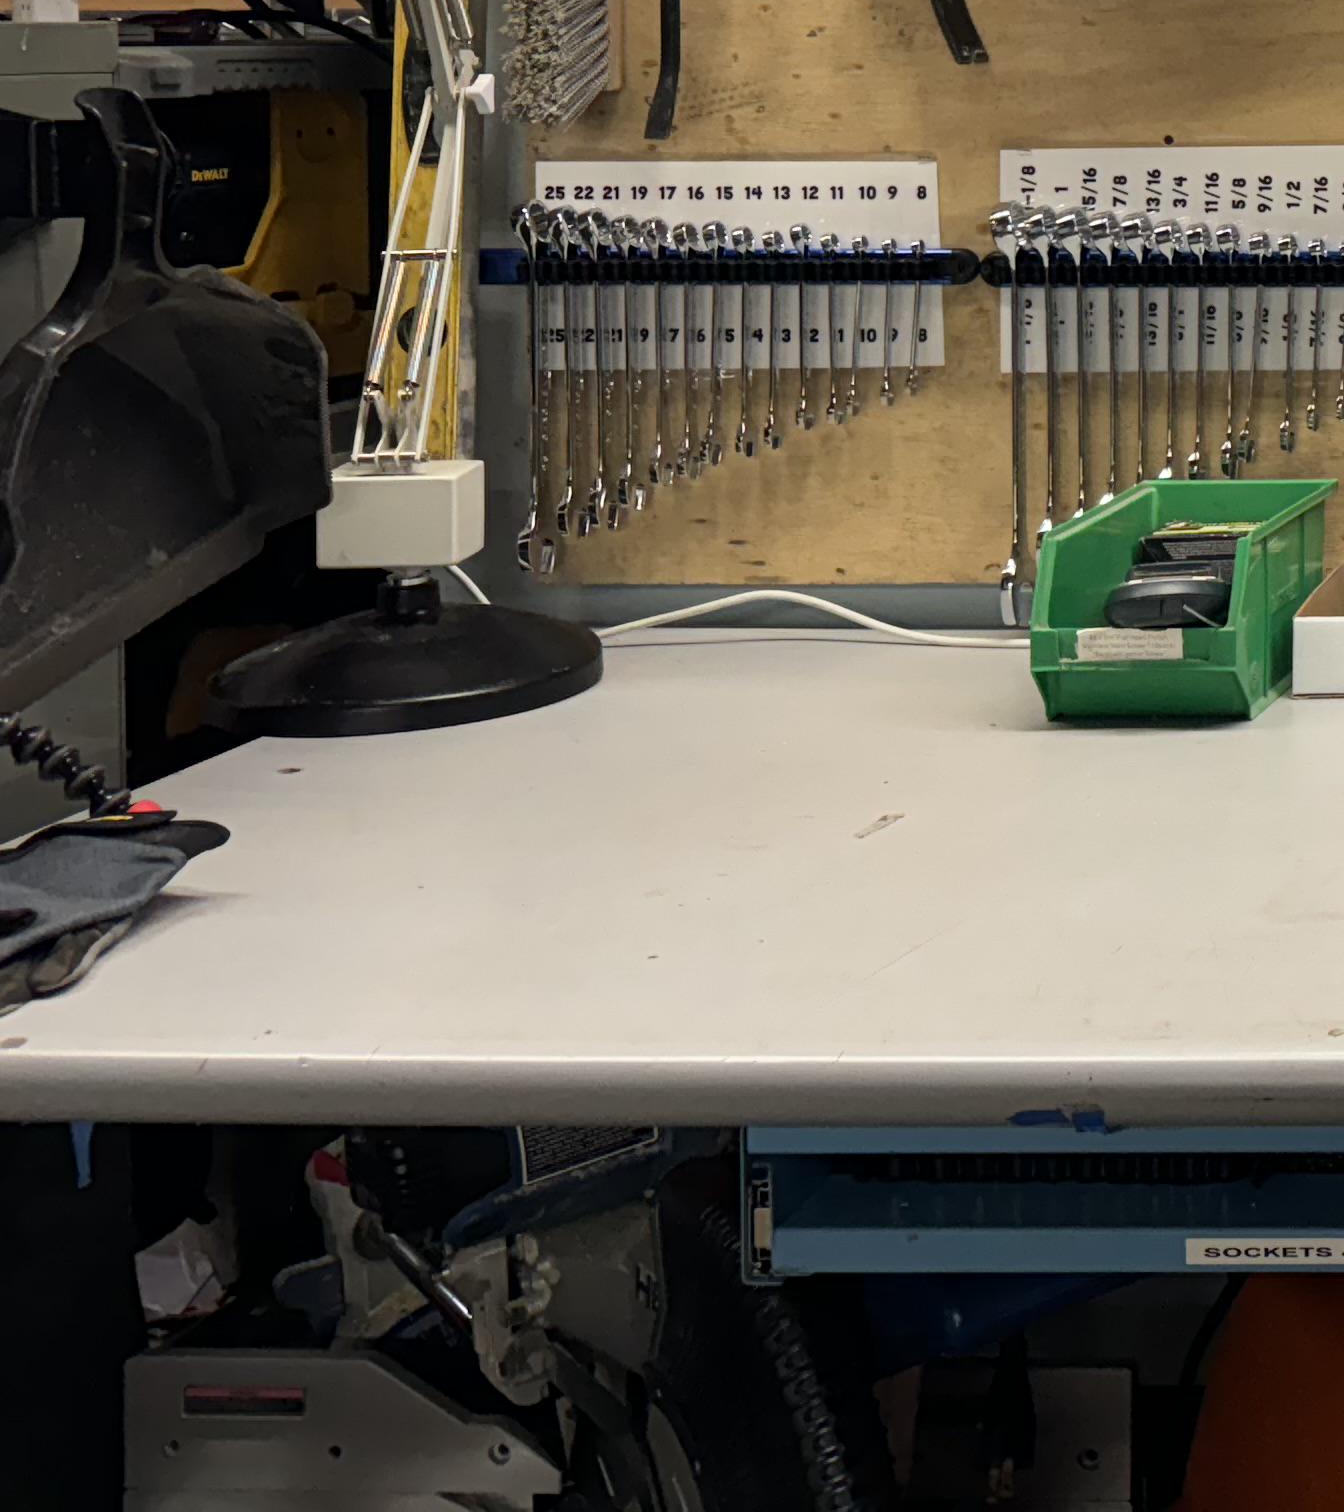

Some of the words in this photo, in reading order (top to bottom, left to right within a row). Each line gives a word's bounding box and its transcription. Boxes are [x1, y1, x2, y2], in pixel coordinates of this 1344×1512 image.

[190, 166, 230, 183] DEWALT
[544, 186, 565, 200] 25
[574, 186, 594, 200] 22
[602, 186, 620, 200] 21
[630, 186, 648, 200] 19
[659, 186, 676, 200] 17
[687, 186, 704, 200] 16
[716, 186, 734, 200] 15
[745, 186, 763, 200] 14
[773, 186, 791, 200] 13
[801, 186, 819, 200] 12
[830, 186, 844, 200] 11
[859, 186, 876, 200] 10
[887, 186, 898, 200] 9
[916, 186, 927, 200] 8
[1113, 175, 1128, 207] 7/8
[1173, 176, 1188, 209] 3/4
[1205, 172, 1220, 213] 11/16
[1231, 177, 1247, 210] 5/8
[1257, 175, 1273, 213] 9/16
[1286, 180, 1301, 210] 1/2
[1314, 176, 1329, 214] 7/16
[860, 328, 877, 343] 10
[1204, 1246, 1333, 1258] SOCKETS
